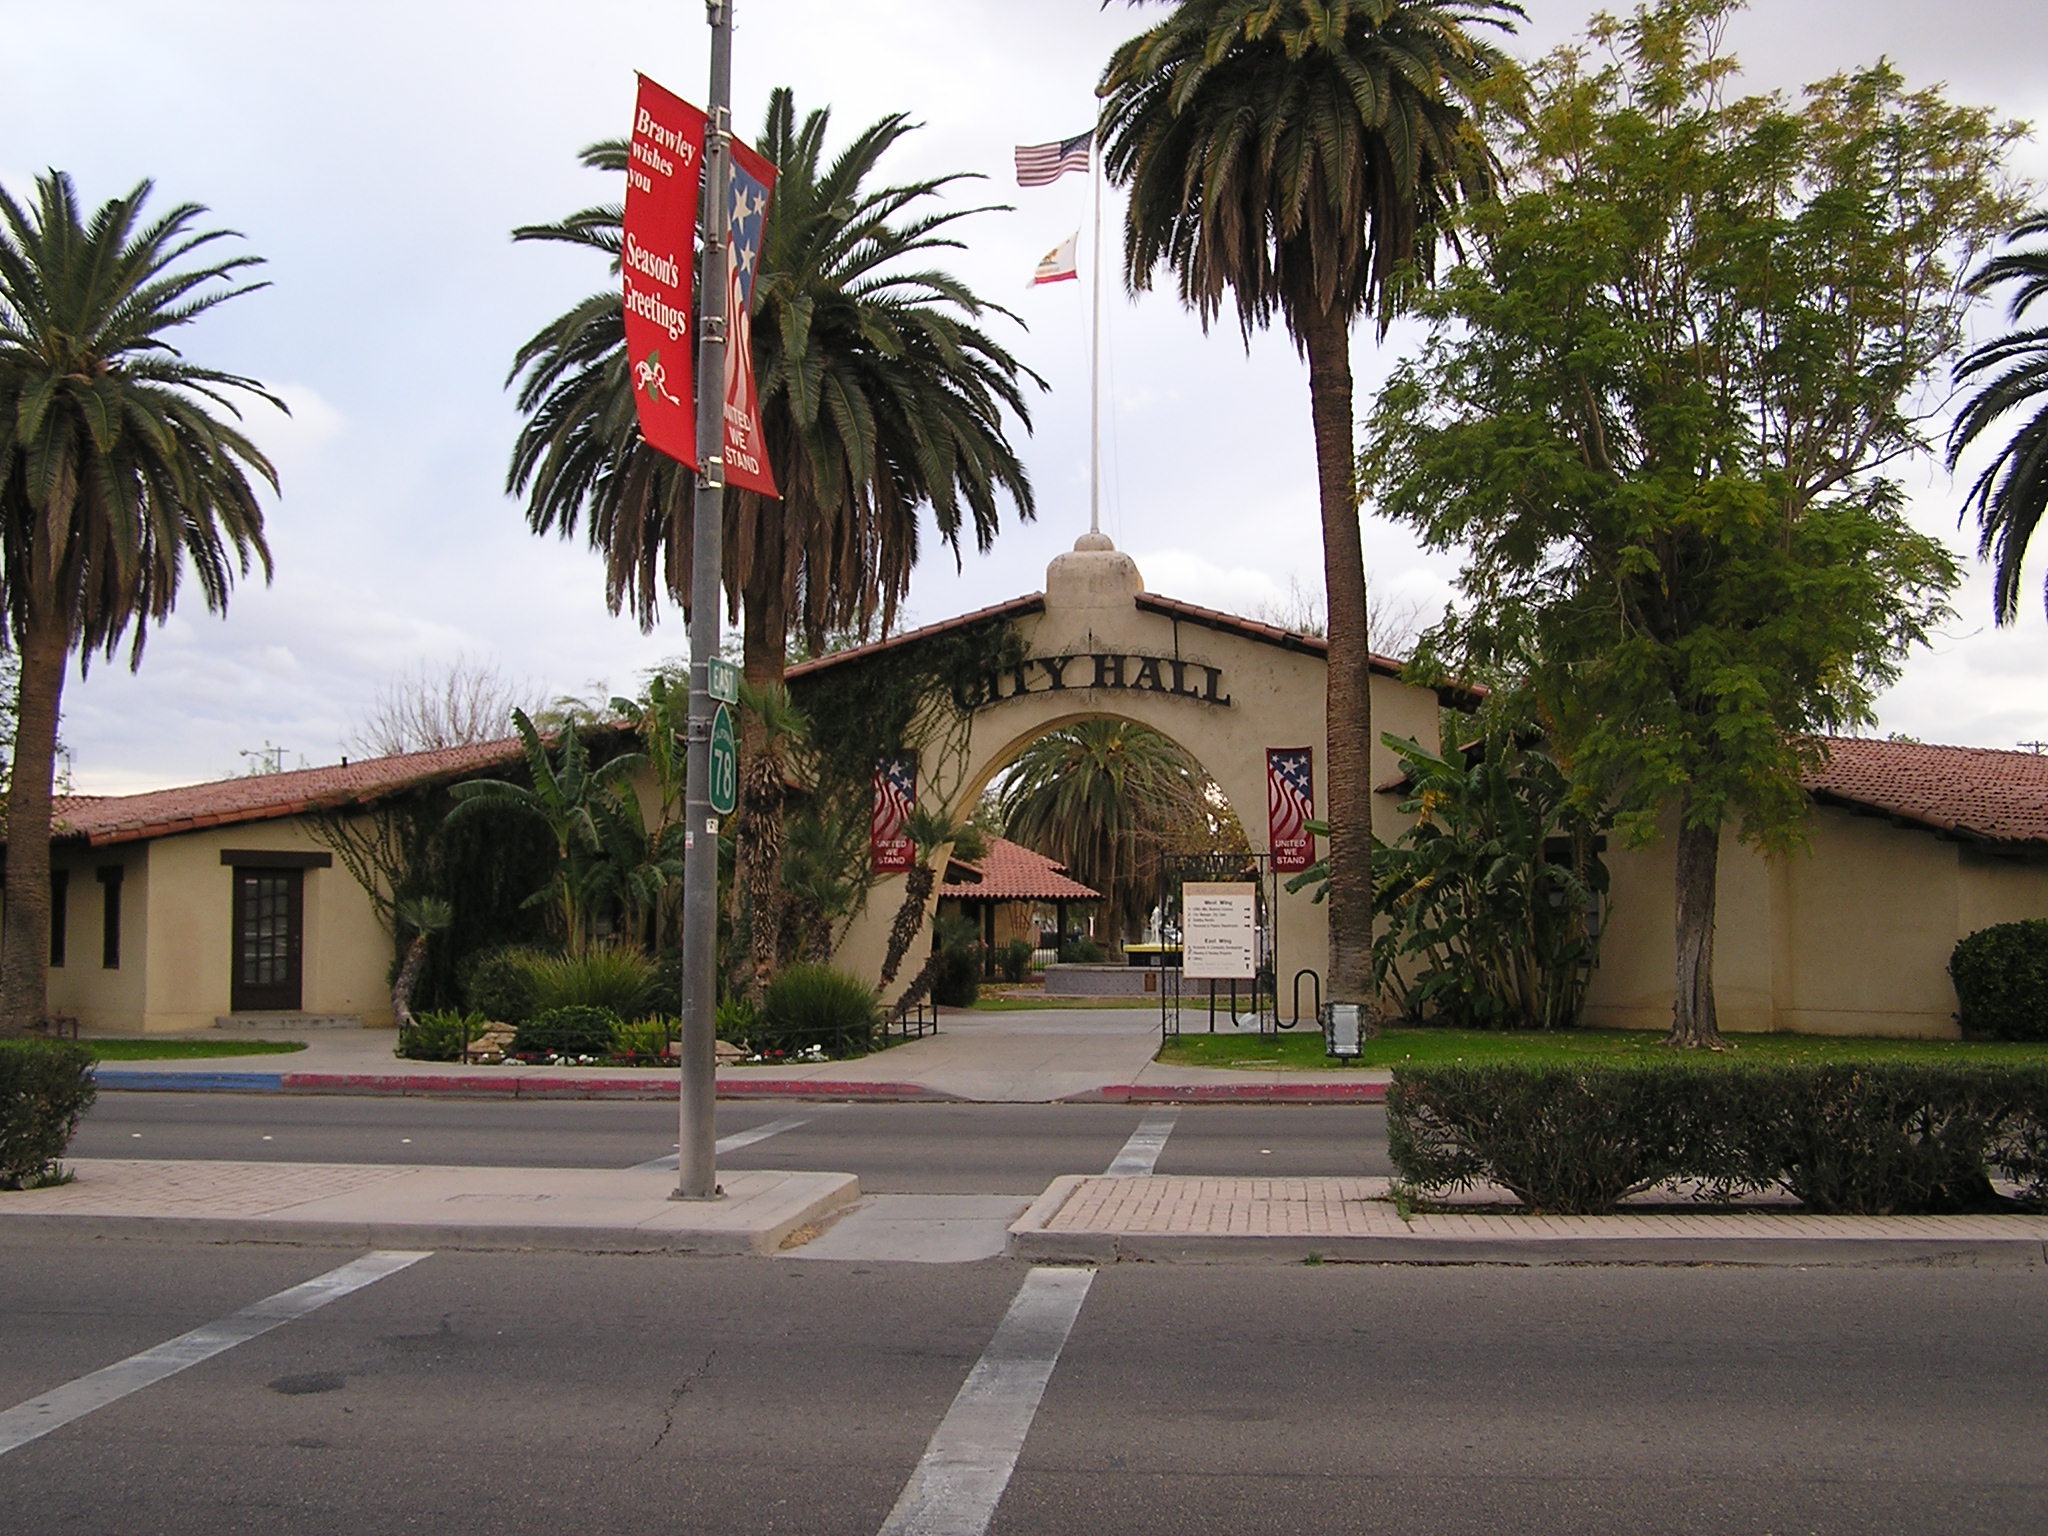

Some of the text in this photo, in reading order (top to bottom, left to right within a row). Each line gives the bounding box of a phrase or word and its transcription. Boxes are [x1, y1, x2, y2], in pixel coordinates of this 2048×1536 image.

[636, 107, 696, 167] Brawley
[632, 142, 673, 178] wishes
[628, 168, 652, 194] you
[626, 232, 679, 288] Season's
[723, 402, 751, 431] NITED
[728, 426, 747, 450] WE
[725, 445, 760, 475] STAND
[714, 665, 734, 695] EAST
[1091, 654, 1231, 706] HALL
[714, 749, 732, 799] 78
[1275, 840, 1306, 848] UNITED
[1283, 848, 1298, 856] WE
[1276, 856, 1305, 865] STAND
